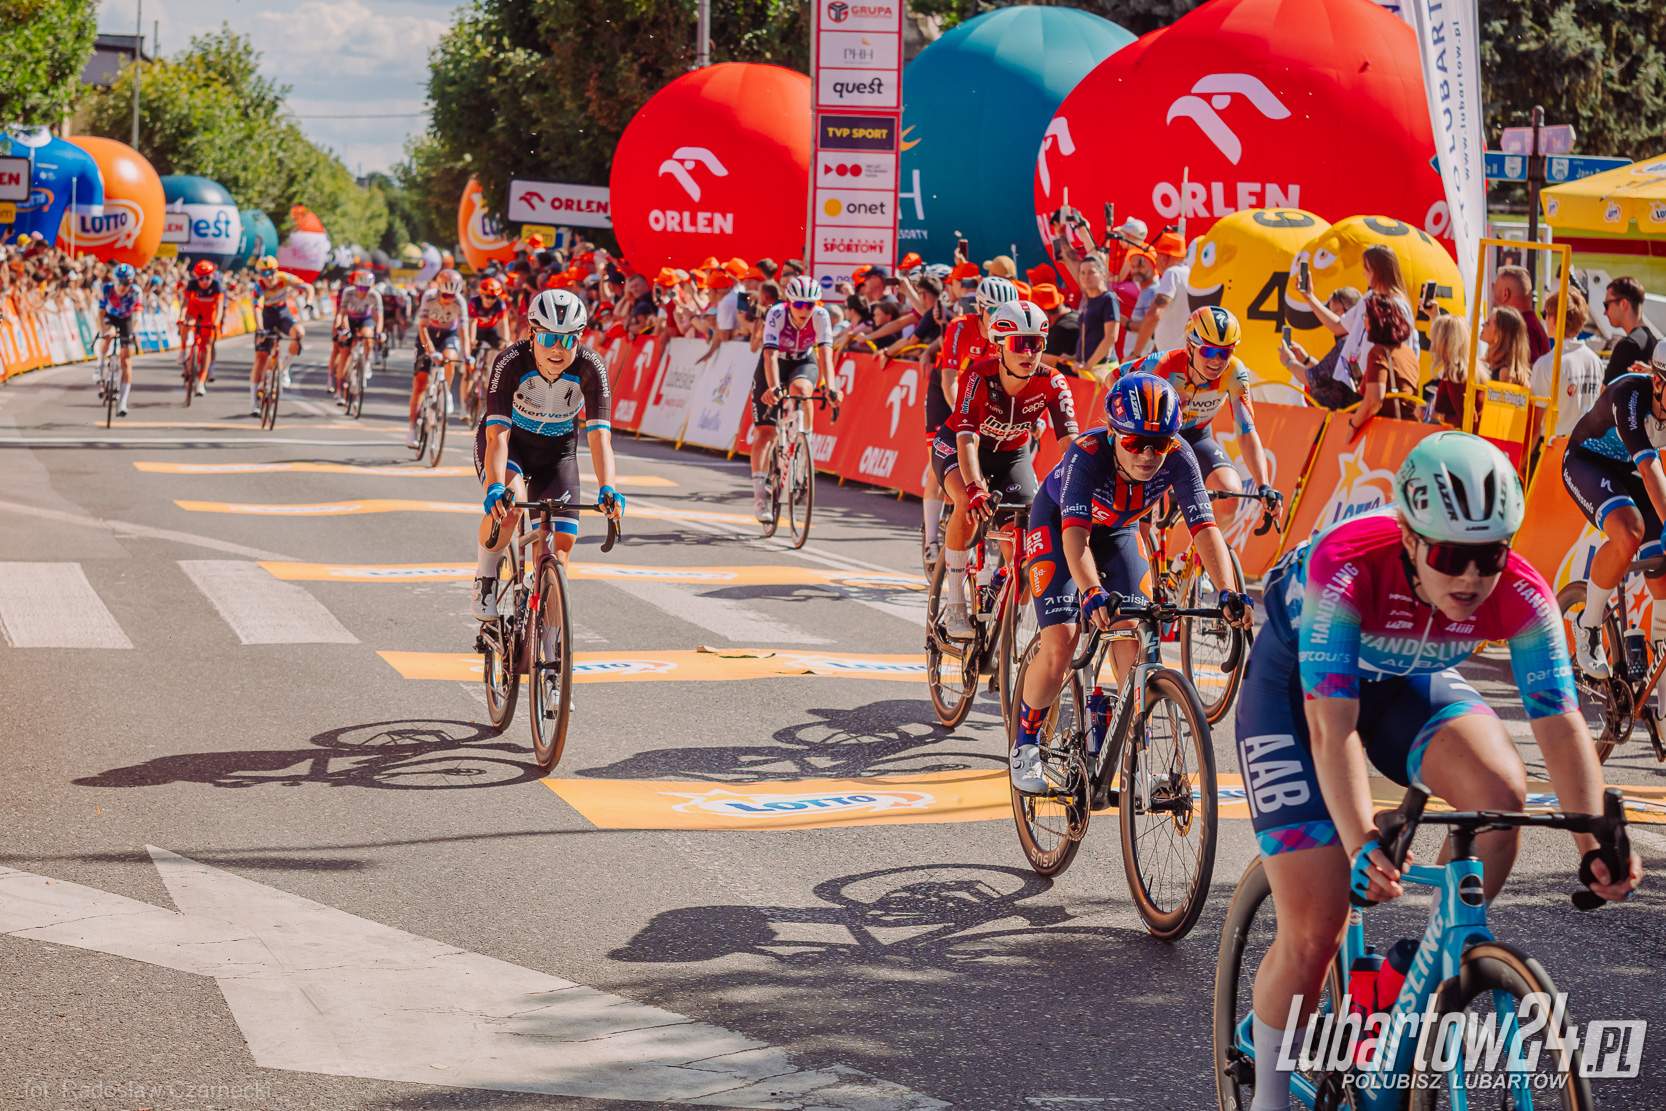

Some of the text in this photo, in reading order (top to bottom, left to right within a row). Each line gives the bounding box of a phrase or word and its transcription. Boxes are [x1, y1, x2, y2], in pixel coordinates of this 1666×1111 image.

[851, 5, 892, 16] GRUPA
[832, 77, 884, 98] quest
[826, 126, 889, 140] TVP SPORT
[550, 197, 609, 213] ORLEN
[846, 201, 886, 215] onet
[1152, 182, 1301, 219] ORLEN
[80, 211, 128, 233] LOTTO
[648, 208, 734, 234] ORLEN
[858, 446, 899, 479] ORLEN
[1433, 473, 1459, 521] LAZER
[1310, 562, 1359, 644] HANDSLING
[1243, 733, 1311, 814] AAB
[726, 794, 880, 813] LOTTO
